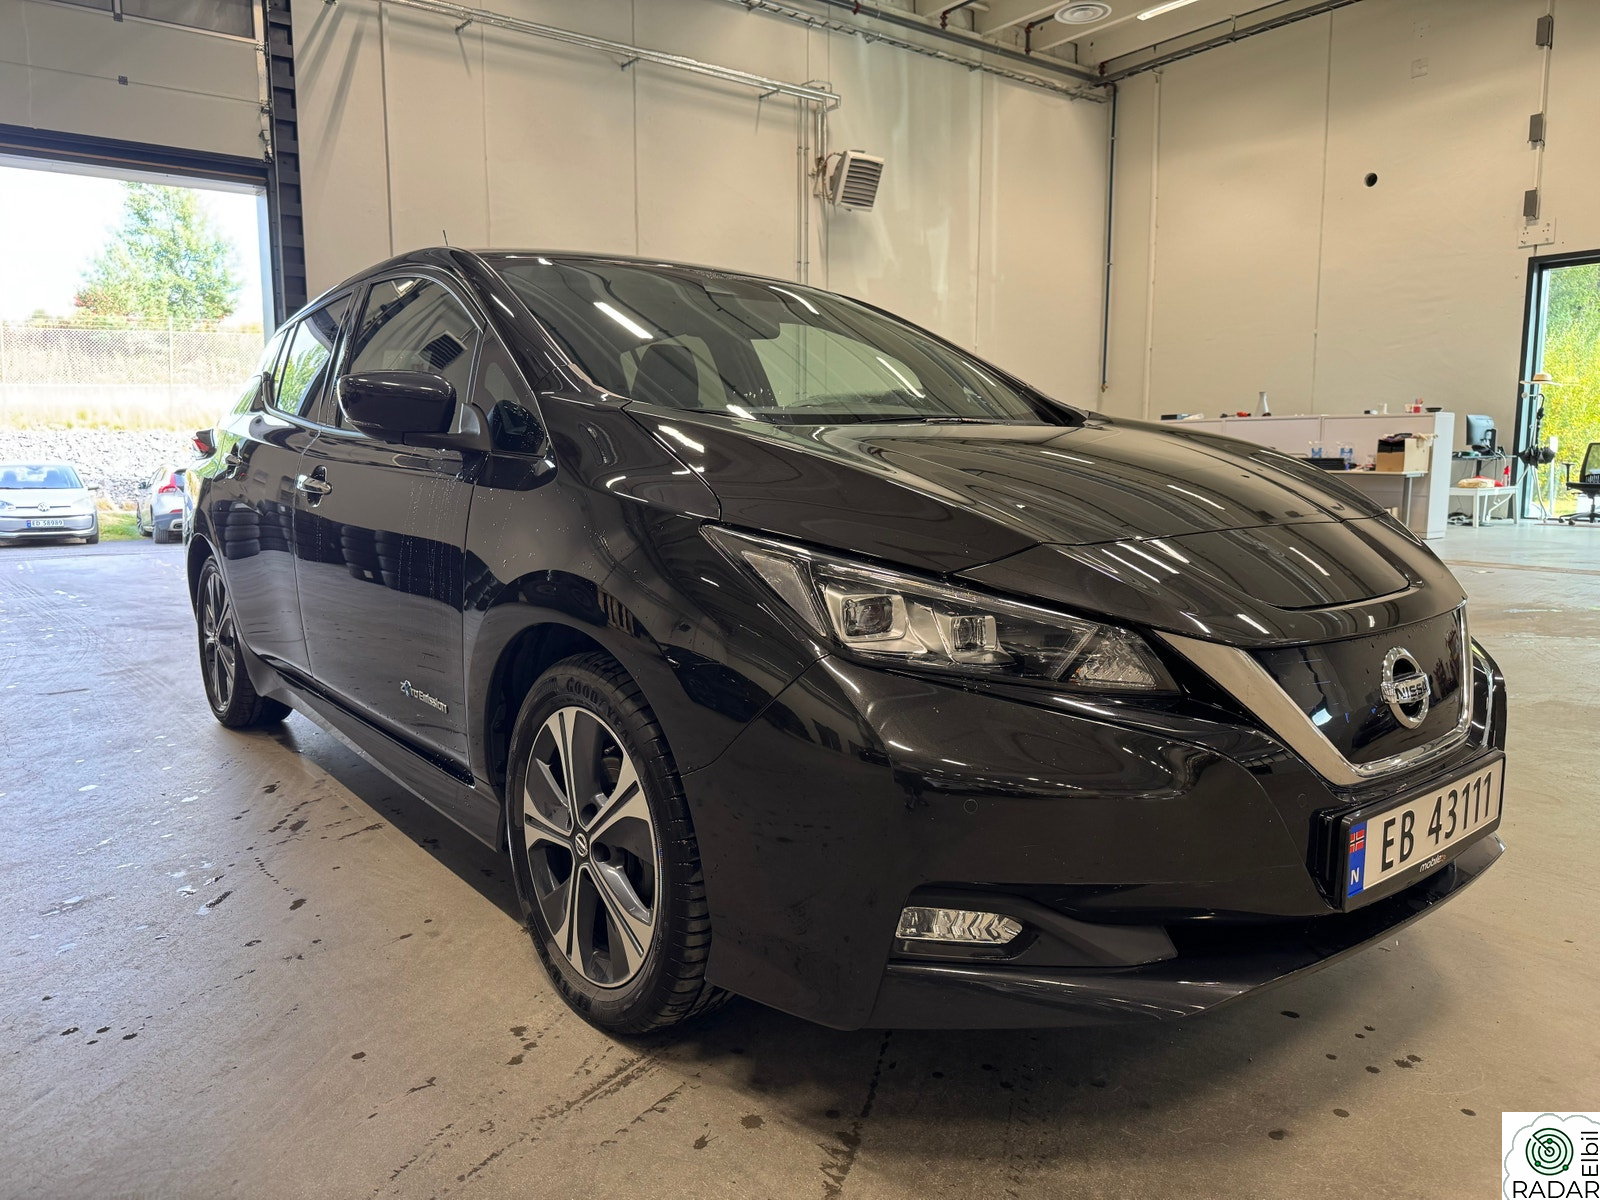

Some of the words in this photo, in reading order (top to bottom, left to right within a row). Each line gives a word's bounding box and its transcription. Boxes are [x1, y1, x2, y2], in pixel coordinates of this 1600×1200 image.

[1381, 810, 1415, 872] EB
[1427, 771, 1492, 845] 43111
[1350, 866, 1360, 885] N
